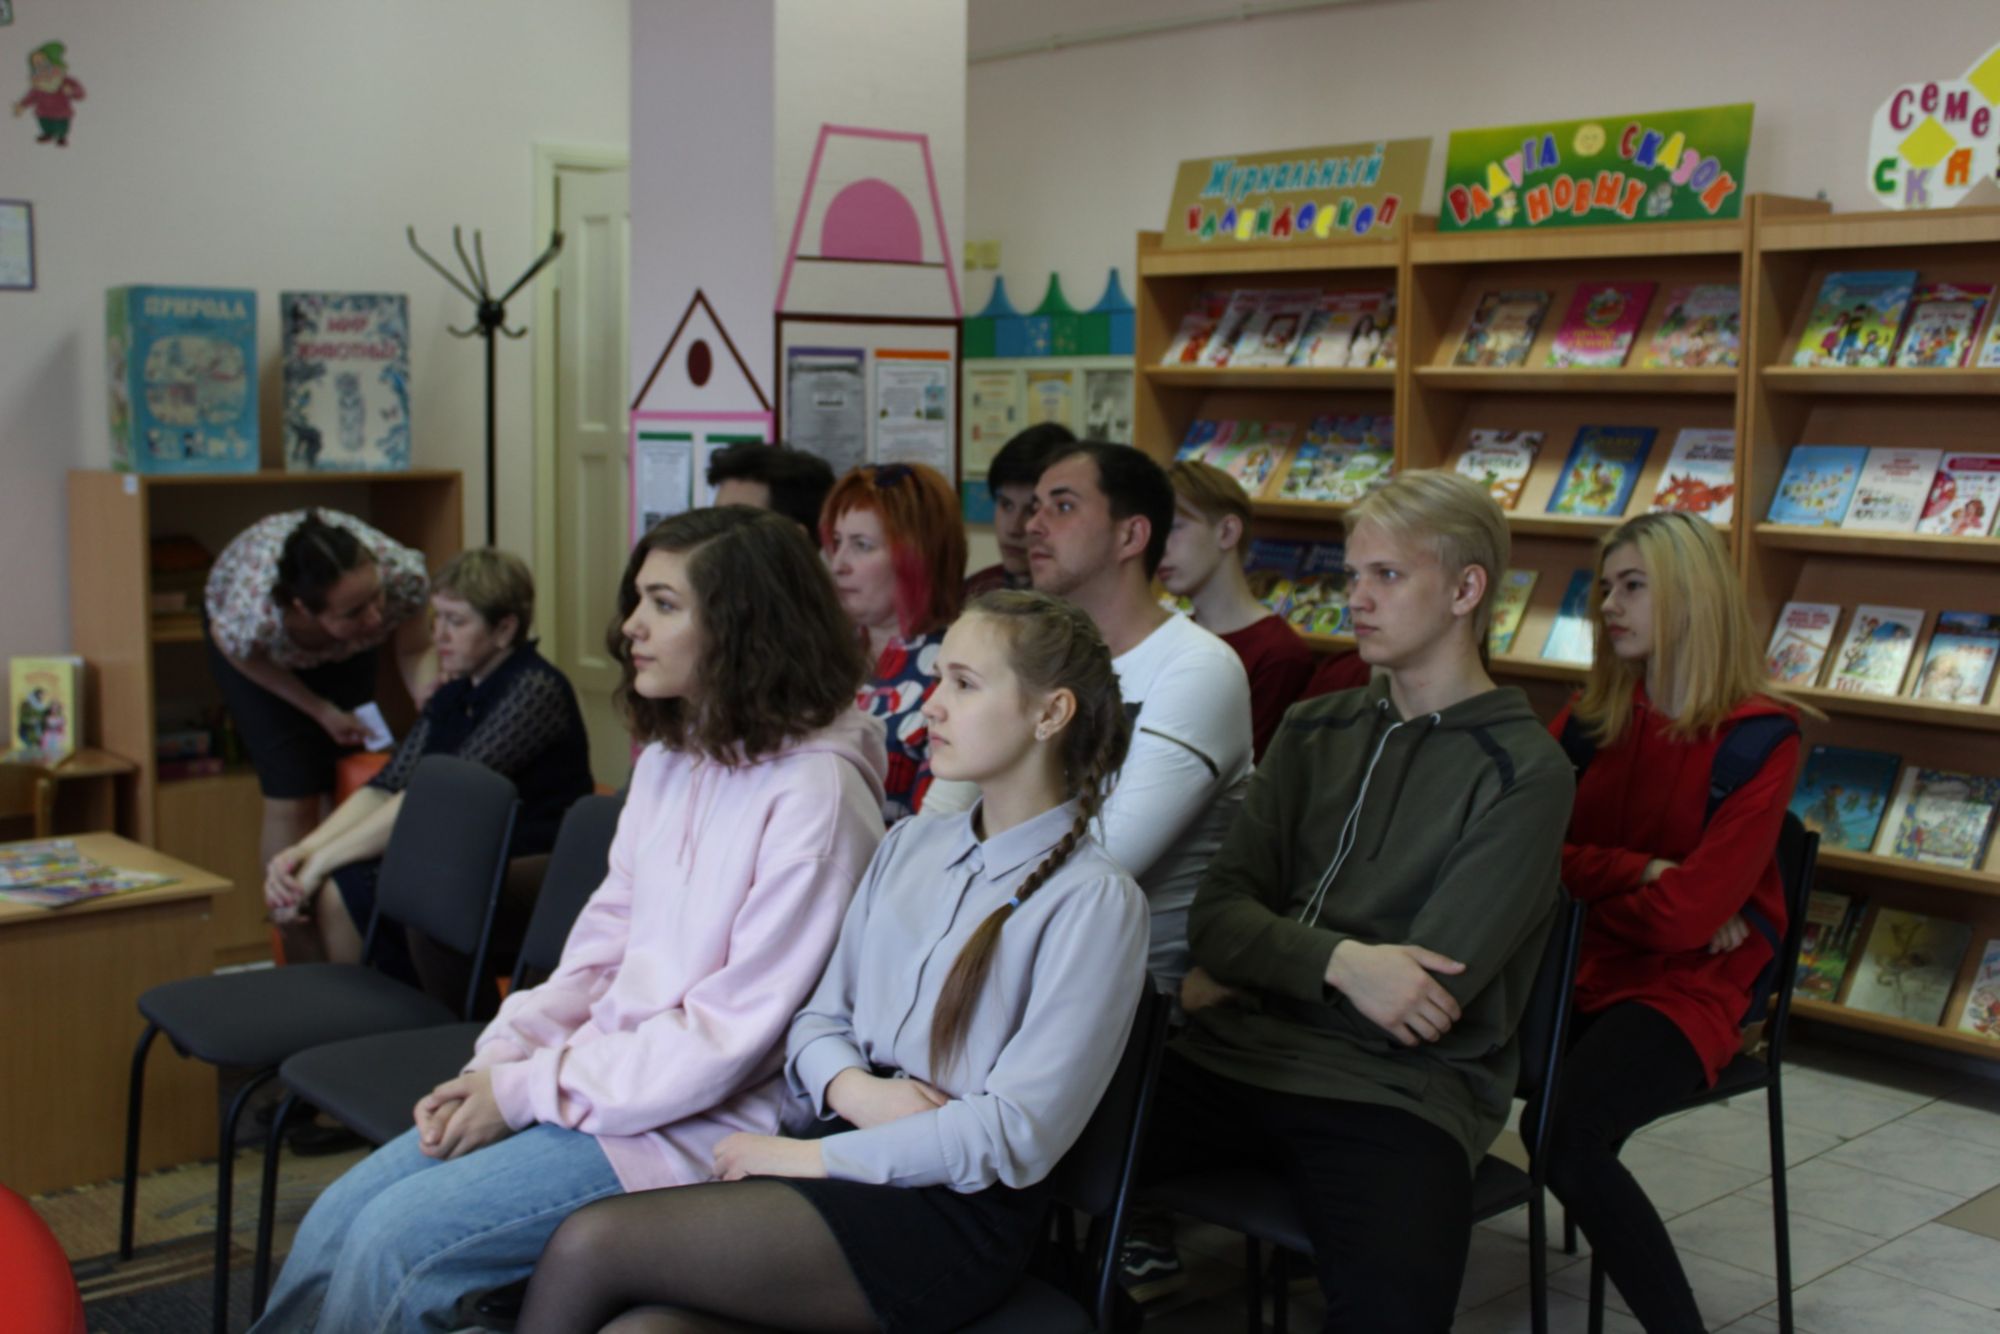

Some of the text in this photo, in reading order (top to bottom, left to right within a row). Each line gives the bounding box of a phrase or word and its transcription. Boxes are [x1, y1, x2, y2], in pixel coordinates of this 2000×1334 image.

[1200, 141, 1386, 204] Журнальный
[1448, 121, 1738, 224] РАДУГА СКАЗОК
[1525, 169, 1648, 224] НОВЫХ
[1874, 147, 2000, 205] СКА
[1186, 194, 1399, 241] КАЛЕЙДОСКОП
